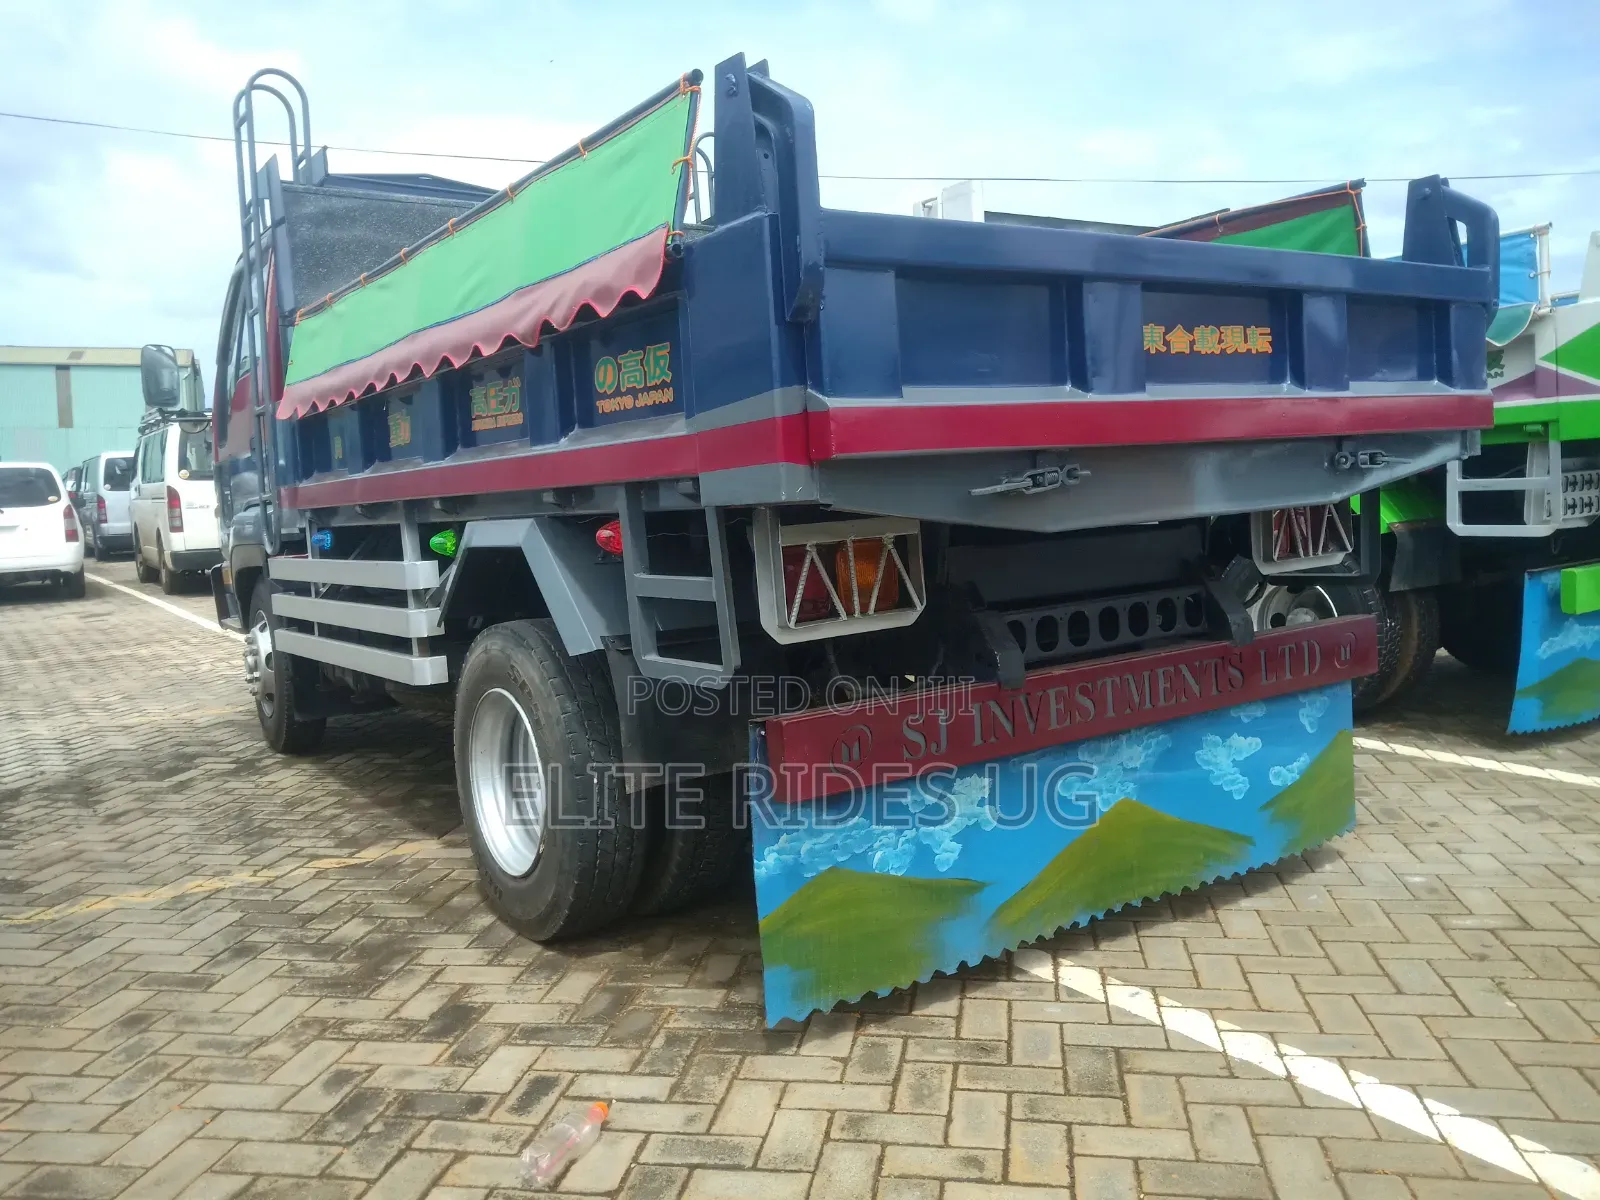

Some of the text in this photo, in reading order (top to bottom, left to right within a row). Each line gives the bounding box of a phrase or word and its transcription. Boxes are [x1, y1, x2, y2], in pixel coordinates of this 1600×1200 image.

[596, 387, 674, 414] TOKYO JAPAN
[902, 708, 949, 760] SJ
[972, 651, 1245, 747] INVESTMENTS
[1259, 639, 1321, 687] LTD
